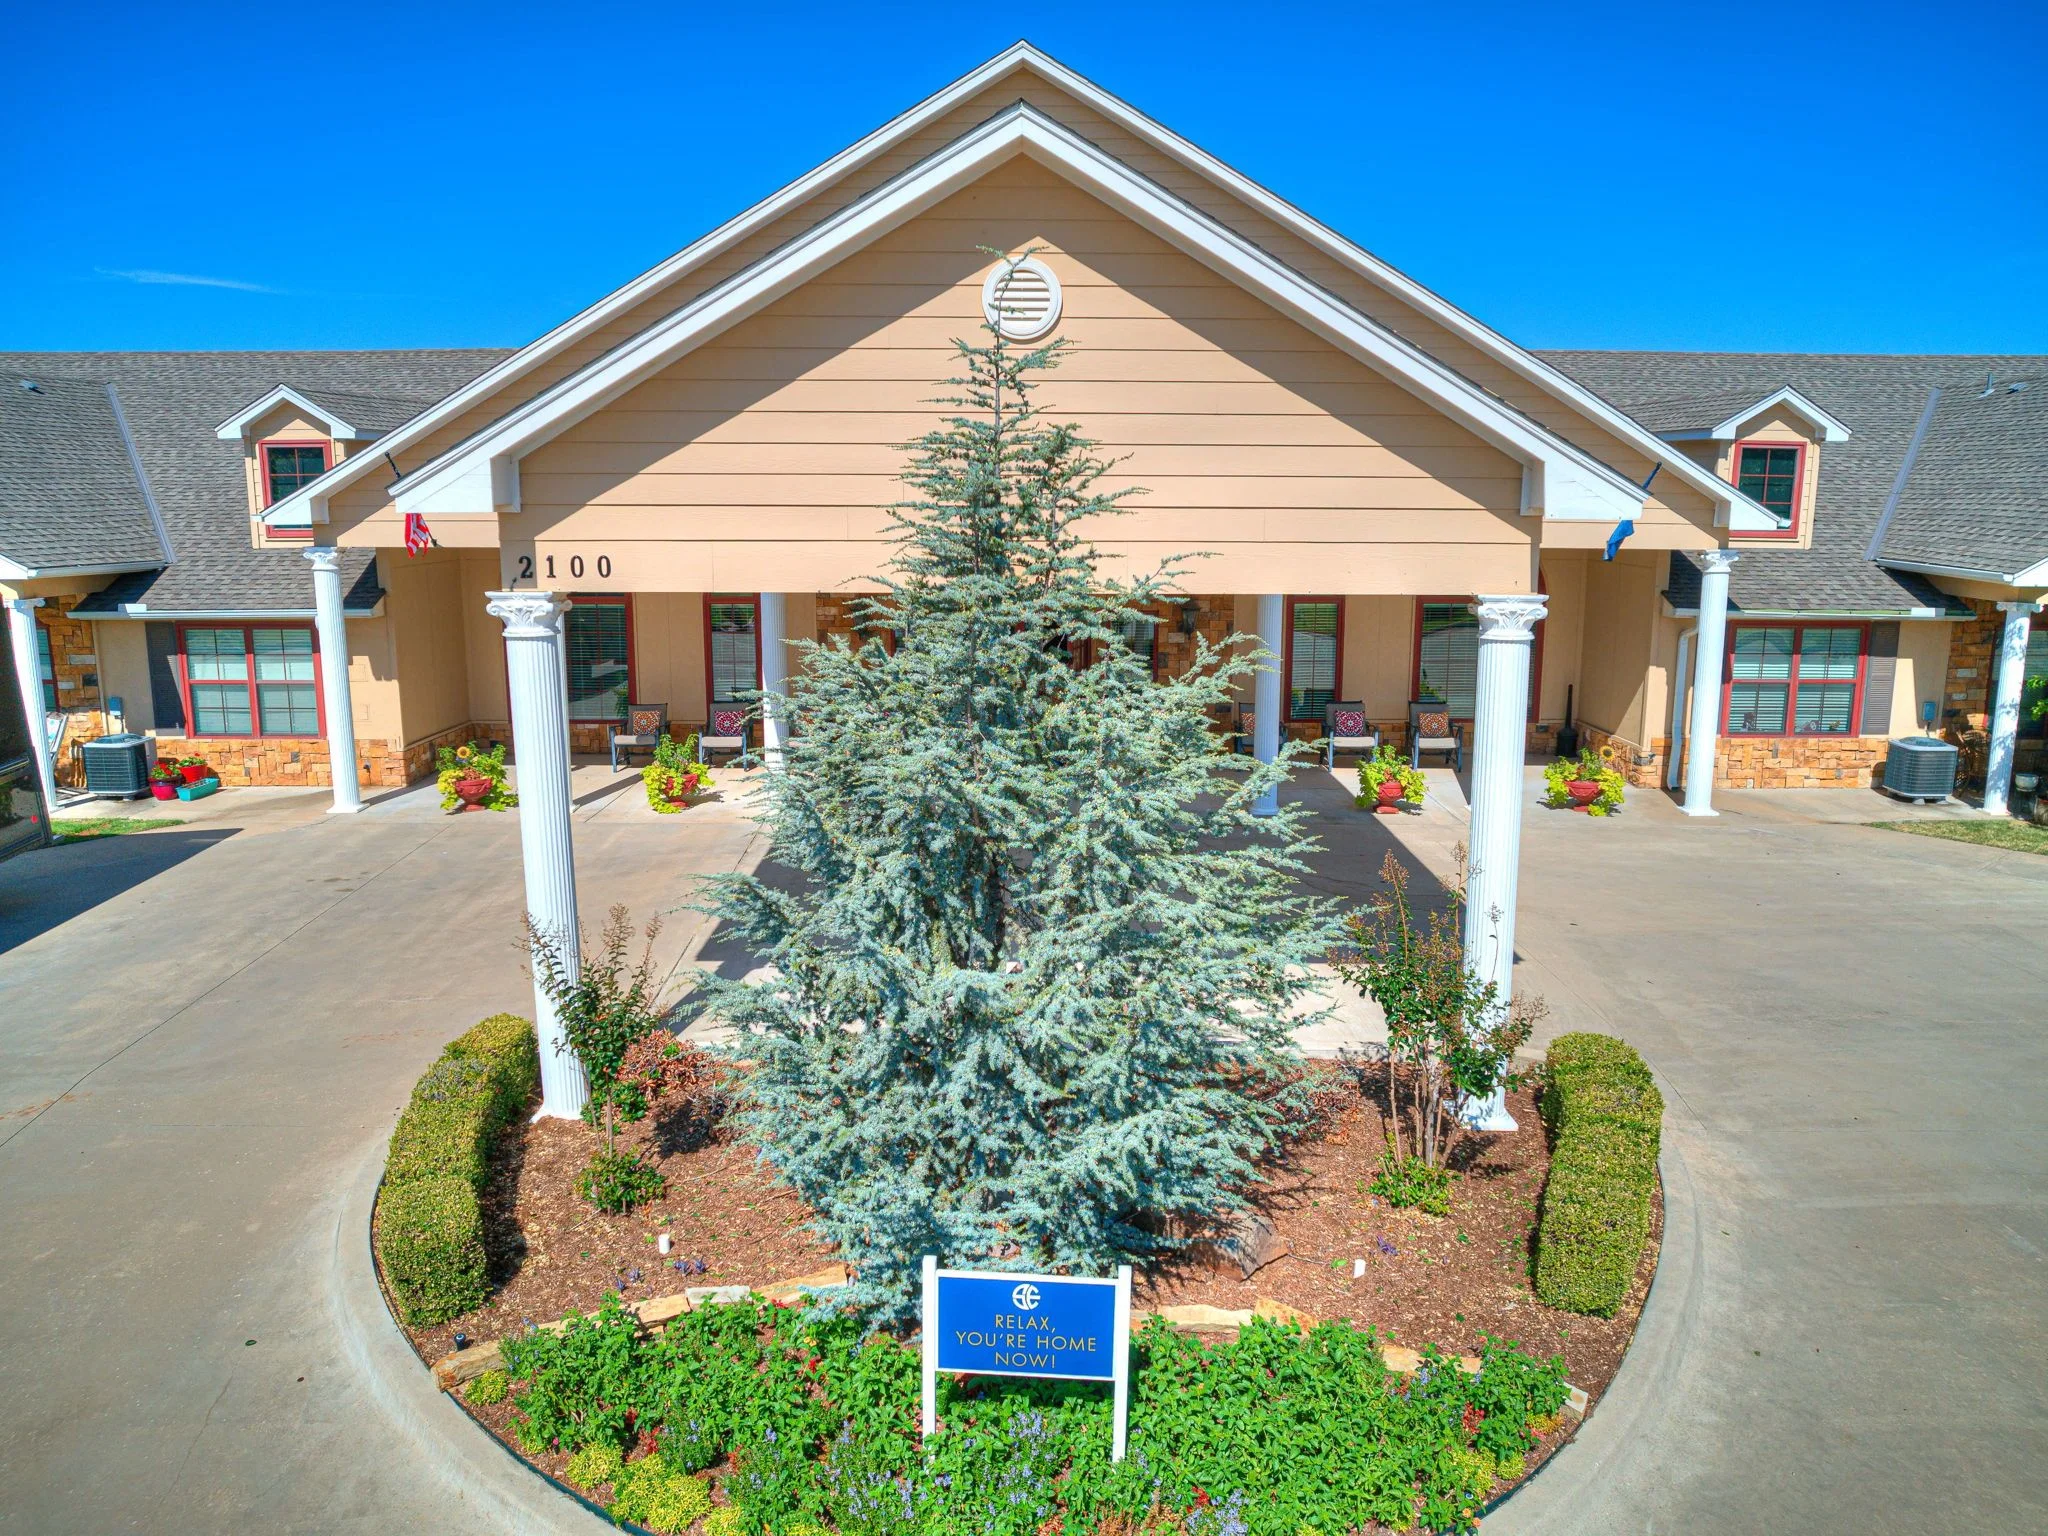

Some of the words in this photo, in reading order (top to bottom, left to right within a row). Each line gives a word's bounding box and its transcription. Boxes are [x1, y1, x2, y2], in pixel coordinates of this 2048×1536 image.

[518, 555, 612, 578] 2100
[995, 1314, 1056, 1333] RELAX,
[956, 1331, 1026, 1348] YOU'RE
[1037, 1335, 1096, 1352] HOME
[995, 1351, 1055, 1369] NOW!
